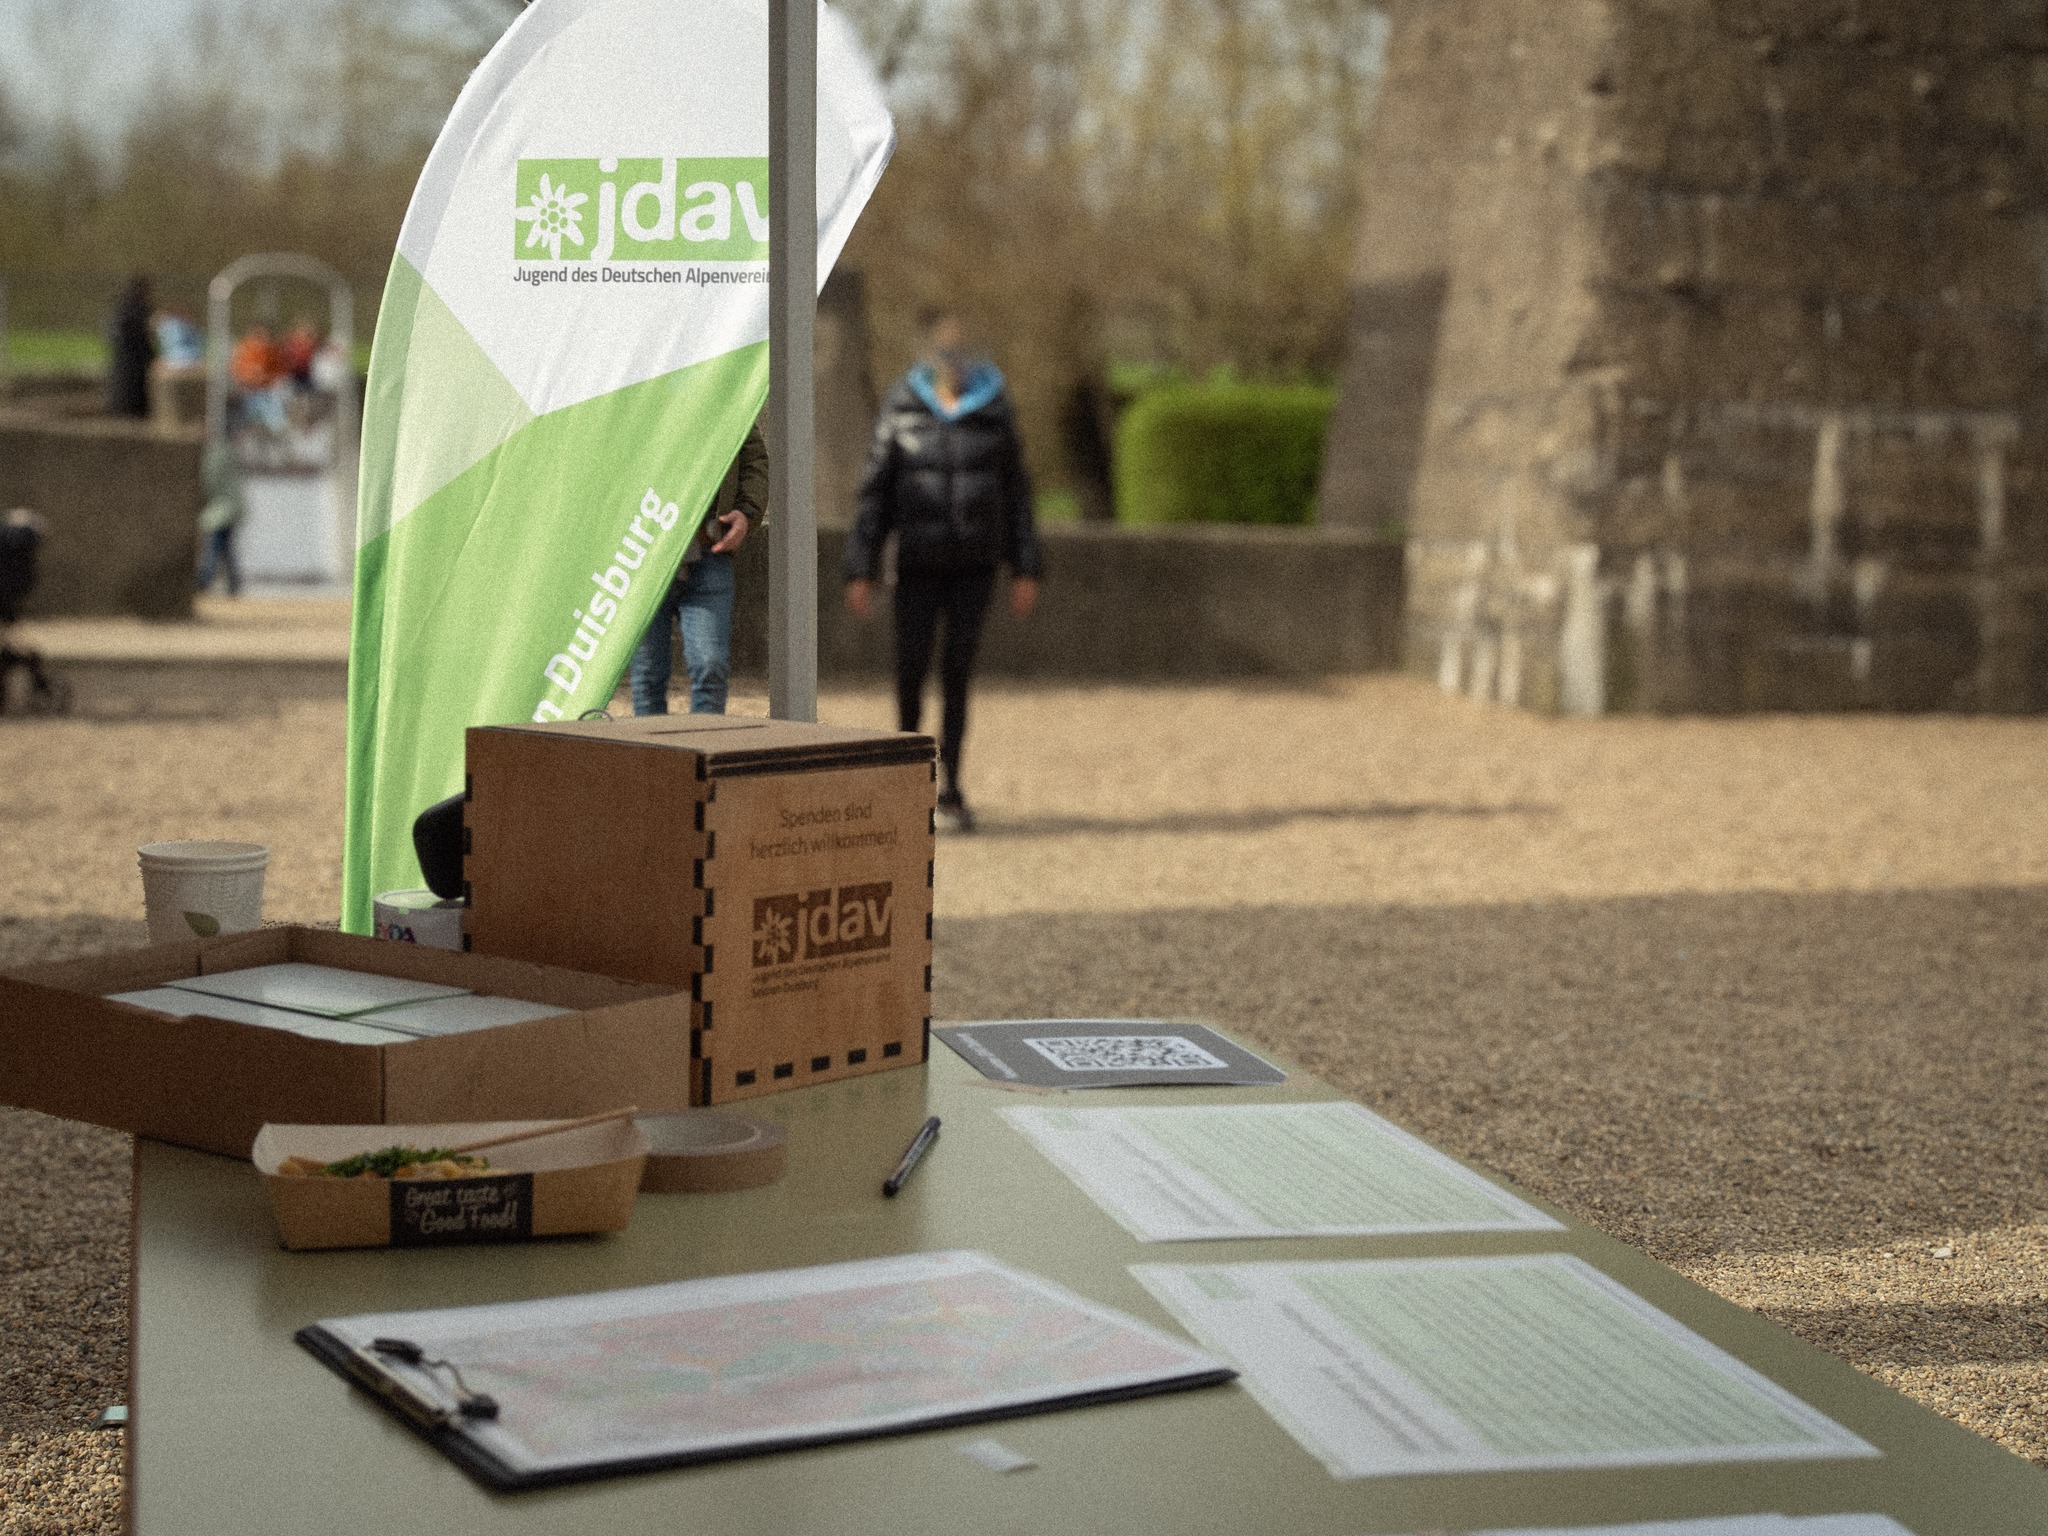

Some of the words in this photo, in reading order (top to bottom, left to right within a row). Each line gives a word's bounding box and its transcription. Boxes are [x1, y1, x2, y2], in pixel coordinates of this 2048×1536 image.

[590, 157, 769, 261] jdav
[513, 267, 567, 286] Jugend
[572, 267, 597, 283] des
[602, 267, 681, 284] Deutschen
[544, 487, 680, 694] Duisburg
[780, 806, 840, 830] Spenden
[844, 801, 872, 821] sind
[794, 885, 894, 963] jdav
